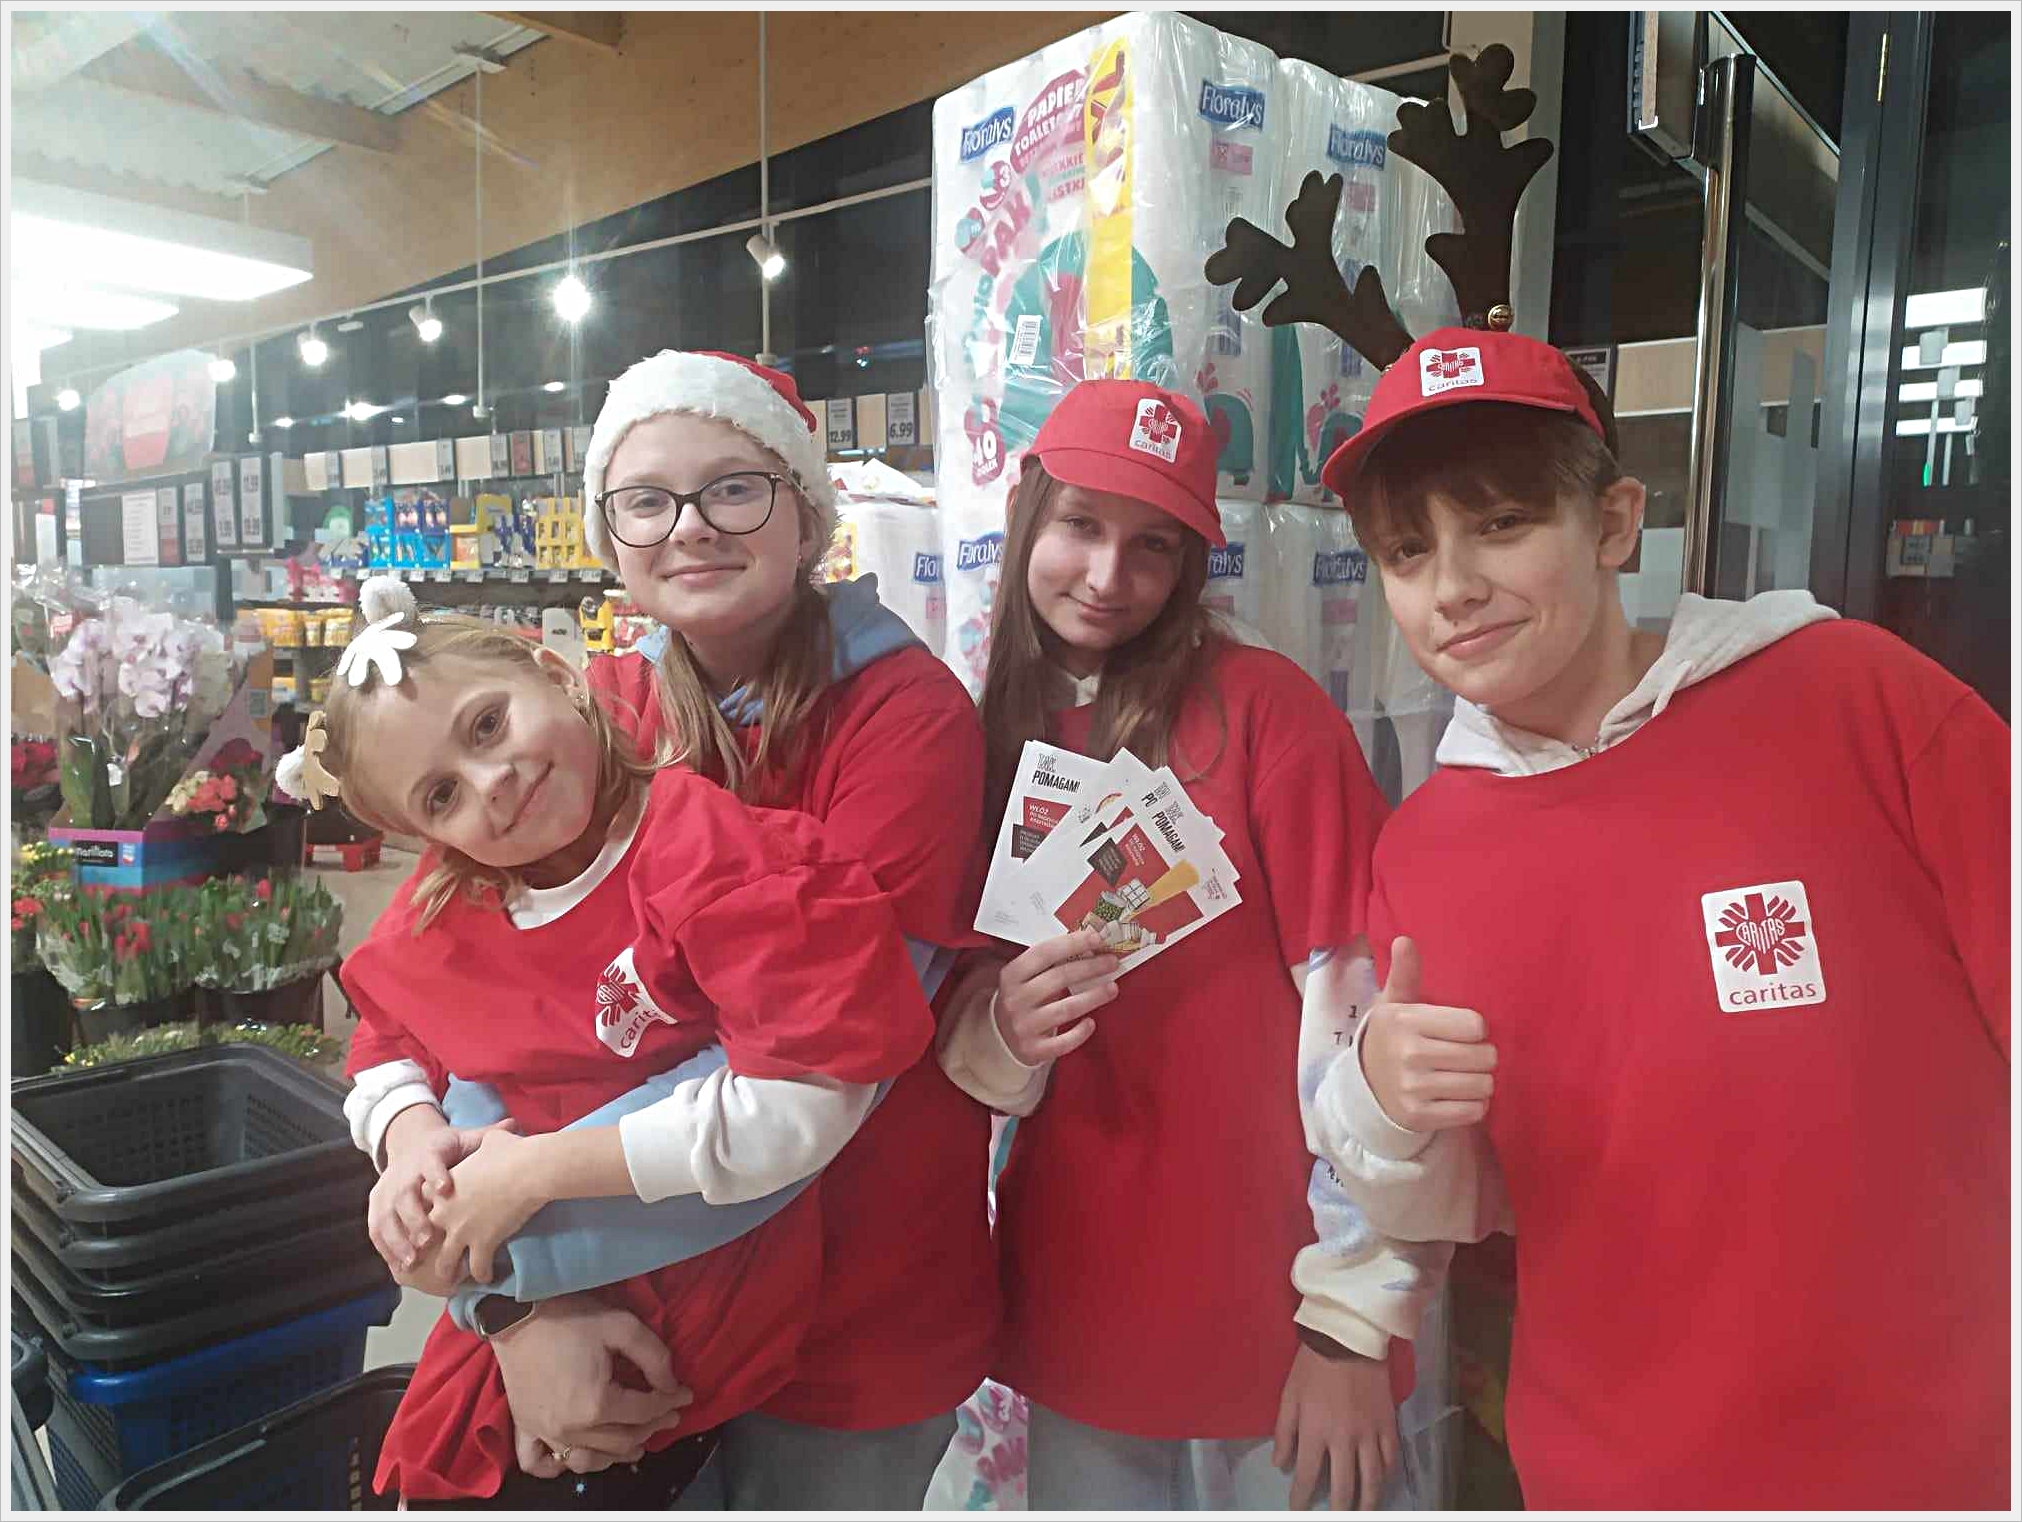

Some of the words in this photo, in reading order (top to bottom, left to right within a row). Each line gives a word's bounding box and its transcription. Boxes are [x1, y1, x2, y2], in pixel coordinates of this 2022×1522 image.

[1202, 85, 1263, 125] Floralys
[890, 421, 914, 439] 6.99
[1031, 770, 1081, 794] POMAGAM!
[1735, 917, 1786, 954] CARITAS
[1729, 982, 1817, 1005] caritas
